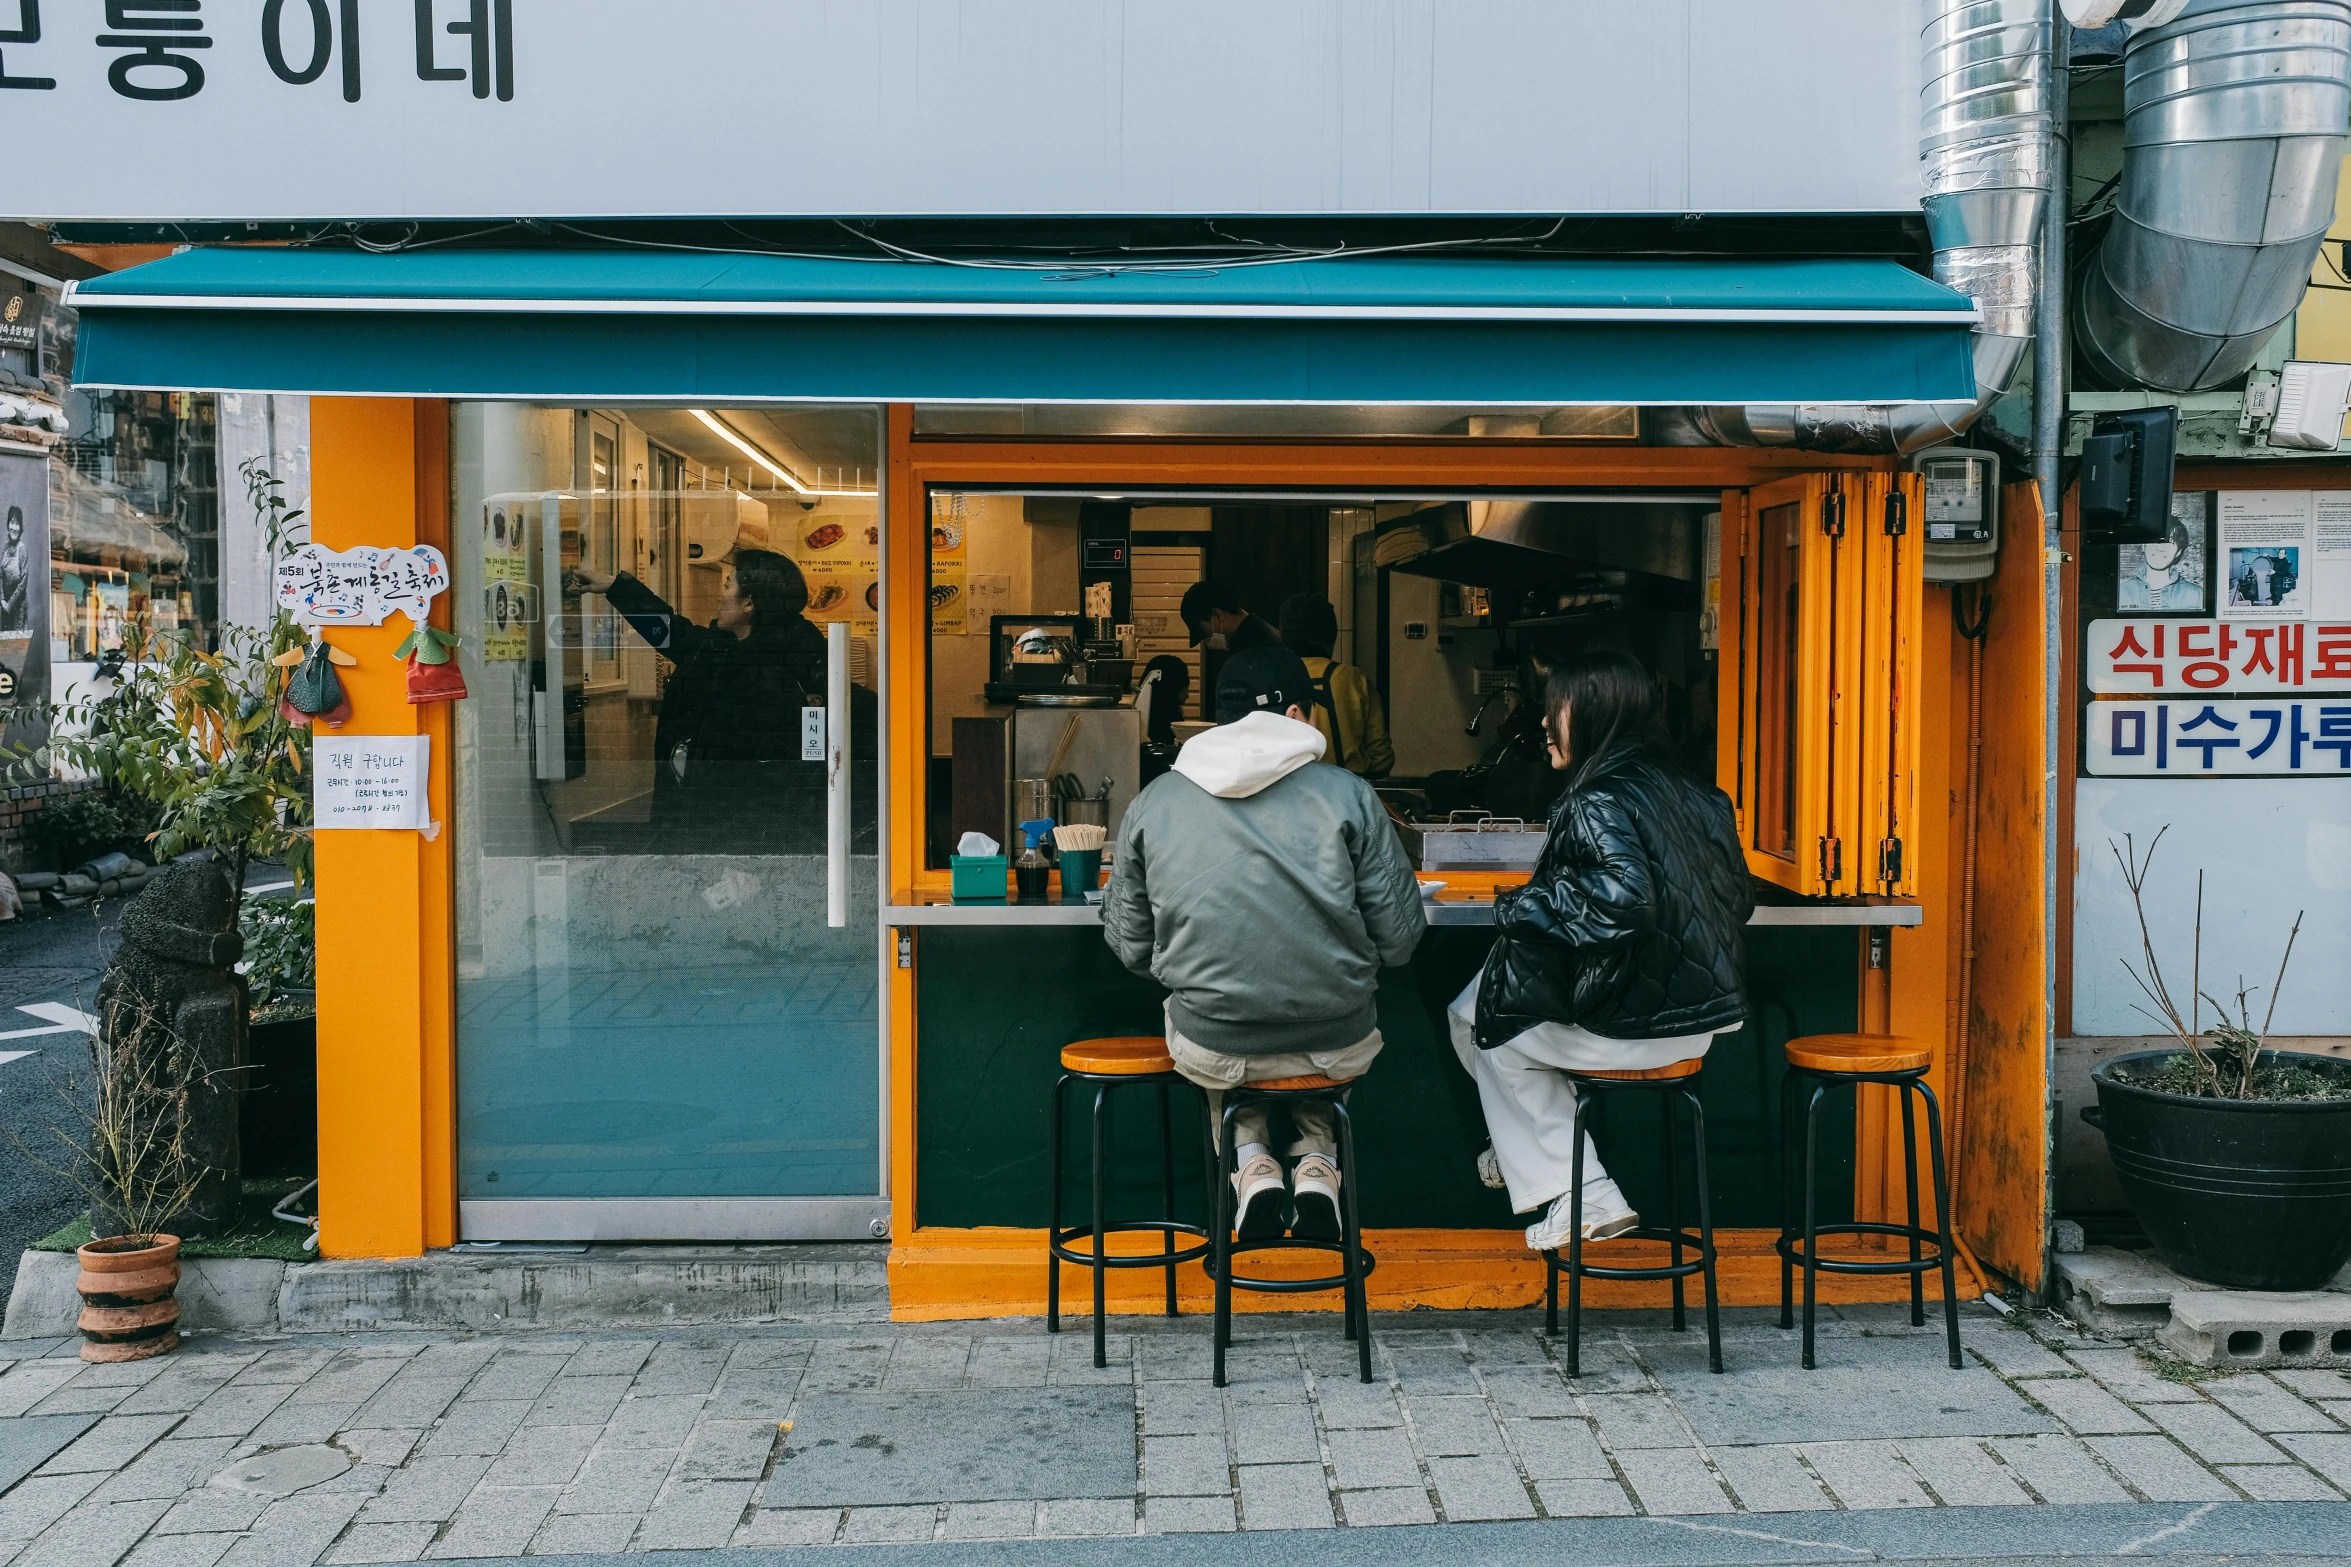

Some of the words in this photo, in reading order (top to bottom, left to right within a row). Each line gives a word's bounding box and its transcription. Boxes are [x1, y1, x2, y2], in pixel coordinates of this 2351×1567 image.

[1113, 549, 1122, 560] 0
[278, 565, 304, 577] 제5회
[300, 562, 341, 596] 북촌
[405, 563, 444, 591] 축제
[2108, 623, 2351, 689] 식당재료
[808, 710, 818, 748] 미시오
[2110, 704, 2351, 769] 미수가루
[329, 753, 353, 769] 직원
[362, 753, 405, 769] 구합니다
